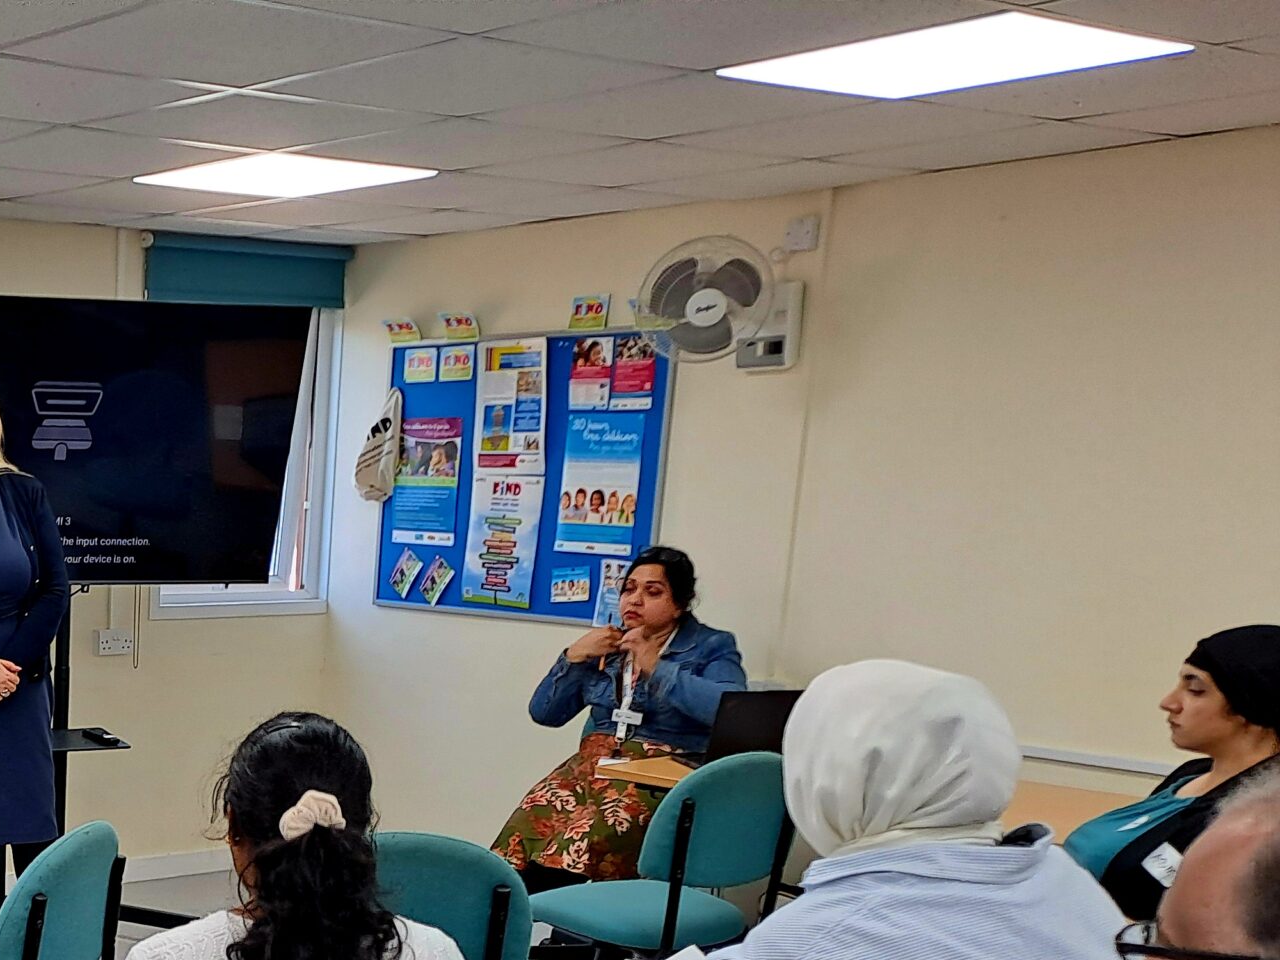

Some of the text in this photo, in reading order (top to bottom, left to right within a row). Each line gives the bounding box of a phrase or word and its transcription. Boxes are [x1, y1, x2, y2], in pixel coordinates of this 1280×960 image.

[64, 516, 71, 526] 3
[60, 536, 150, 547] he input connection.
[83, 554, 112, 564] device
[113, 554, 121, 564] is
[123, 556, 136, 564] on.
